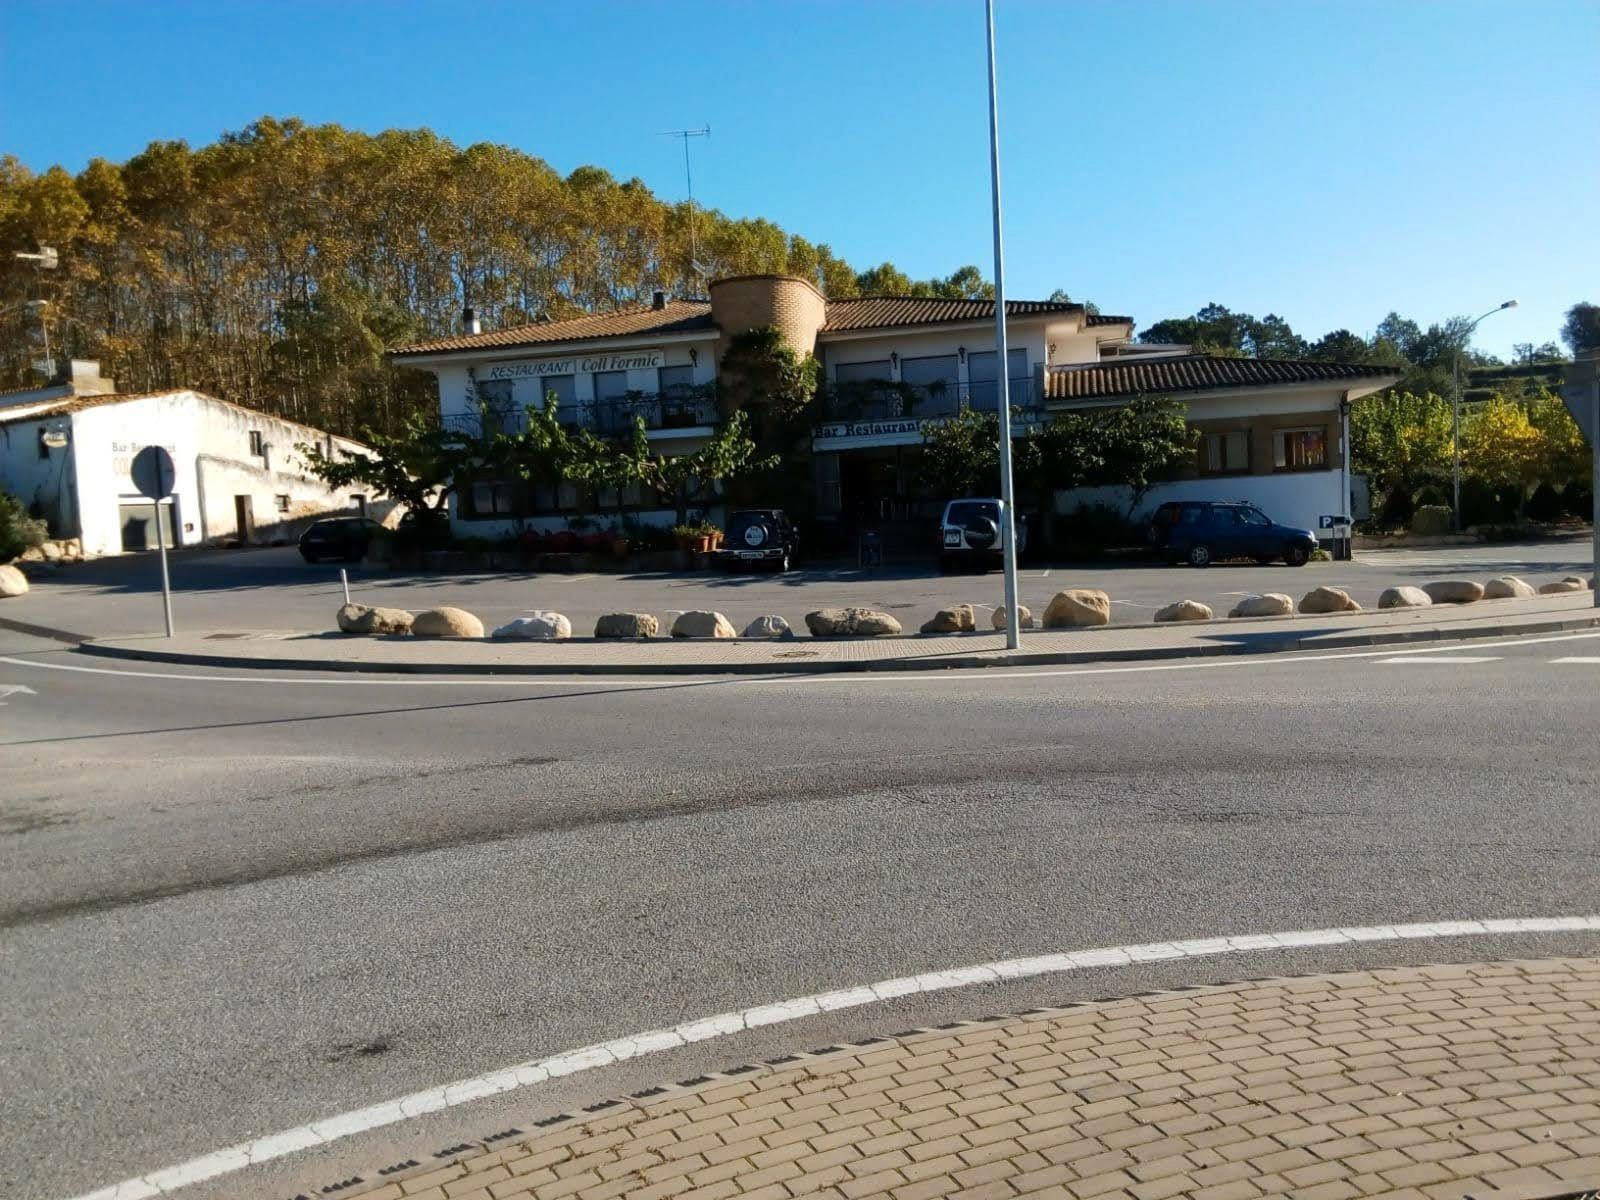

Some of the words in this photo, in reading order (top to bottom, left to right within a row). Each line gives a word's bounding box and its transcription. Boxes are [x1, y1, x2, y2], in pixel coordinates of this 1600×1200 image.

[489, 360, 572, 379] RESTAURANT
[581, 357, 608, 372] Coll
[610, 354, 660, 370] Formic
[814, 424, 839, 439] Bar
[845, 421, 920, 437] Restaurant
